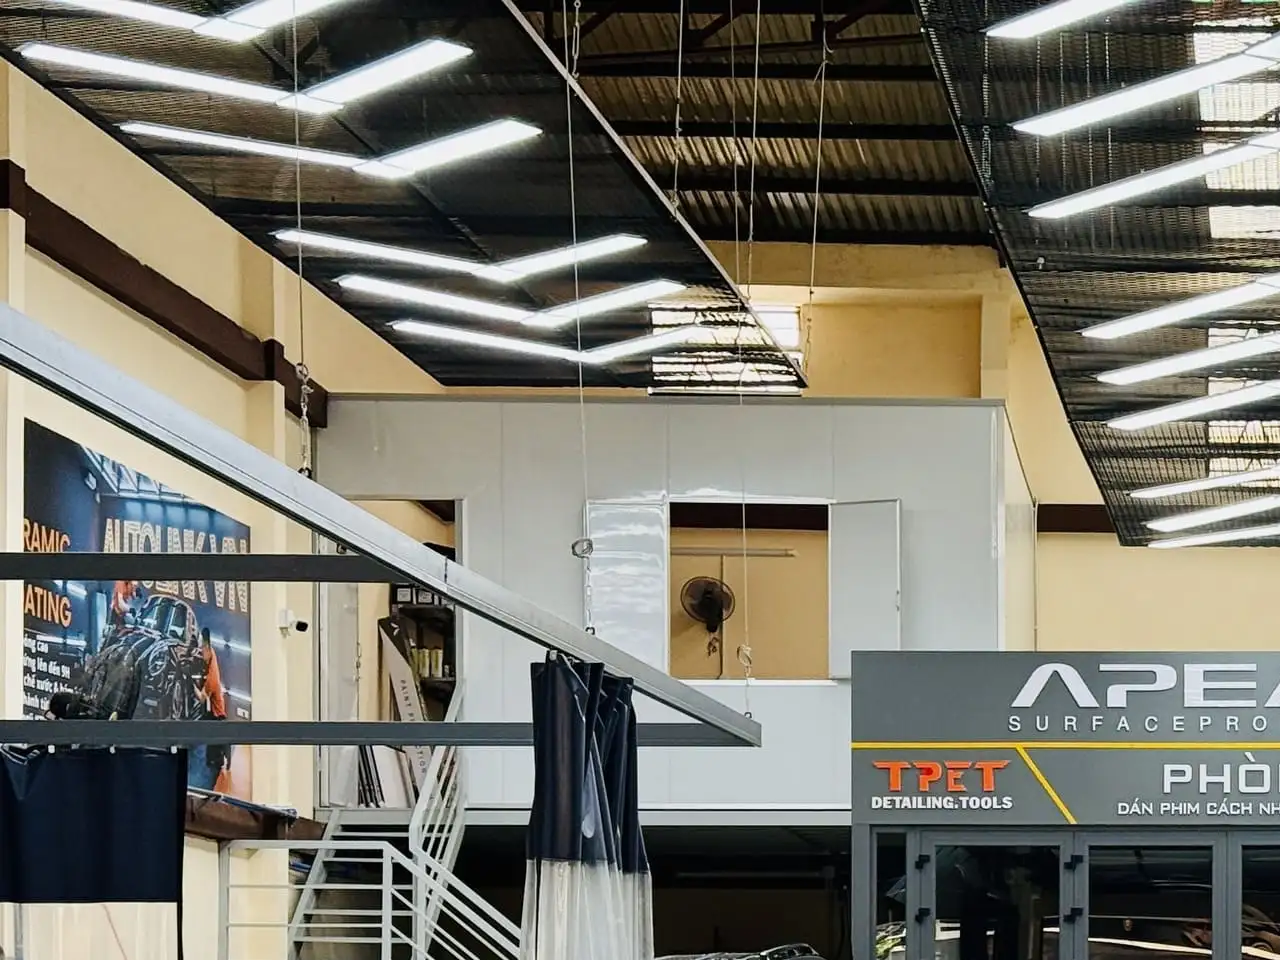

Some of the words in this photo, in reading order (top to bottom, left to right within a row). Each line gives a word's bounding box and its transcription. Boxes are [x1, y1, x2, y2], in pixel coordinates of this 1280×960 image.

[872, 759, 1012, 792] TPET
[871, 796, 1013, 810] DETAILING.TOOLS
[1117, 798, 1153, 815] DÁN
[1160, 802, 1200, 815] PHIM
[1206, 798, 1253, 815] CÁCH
